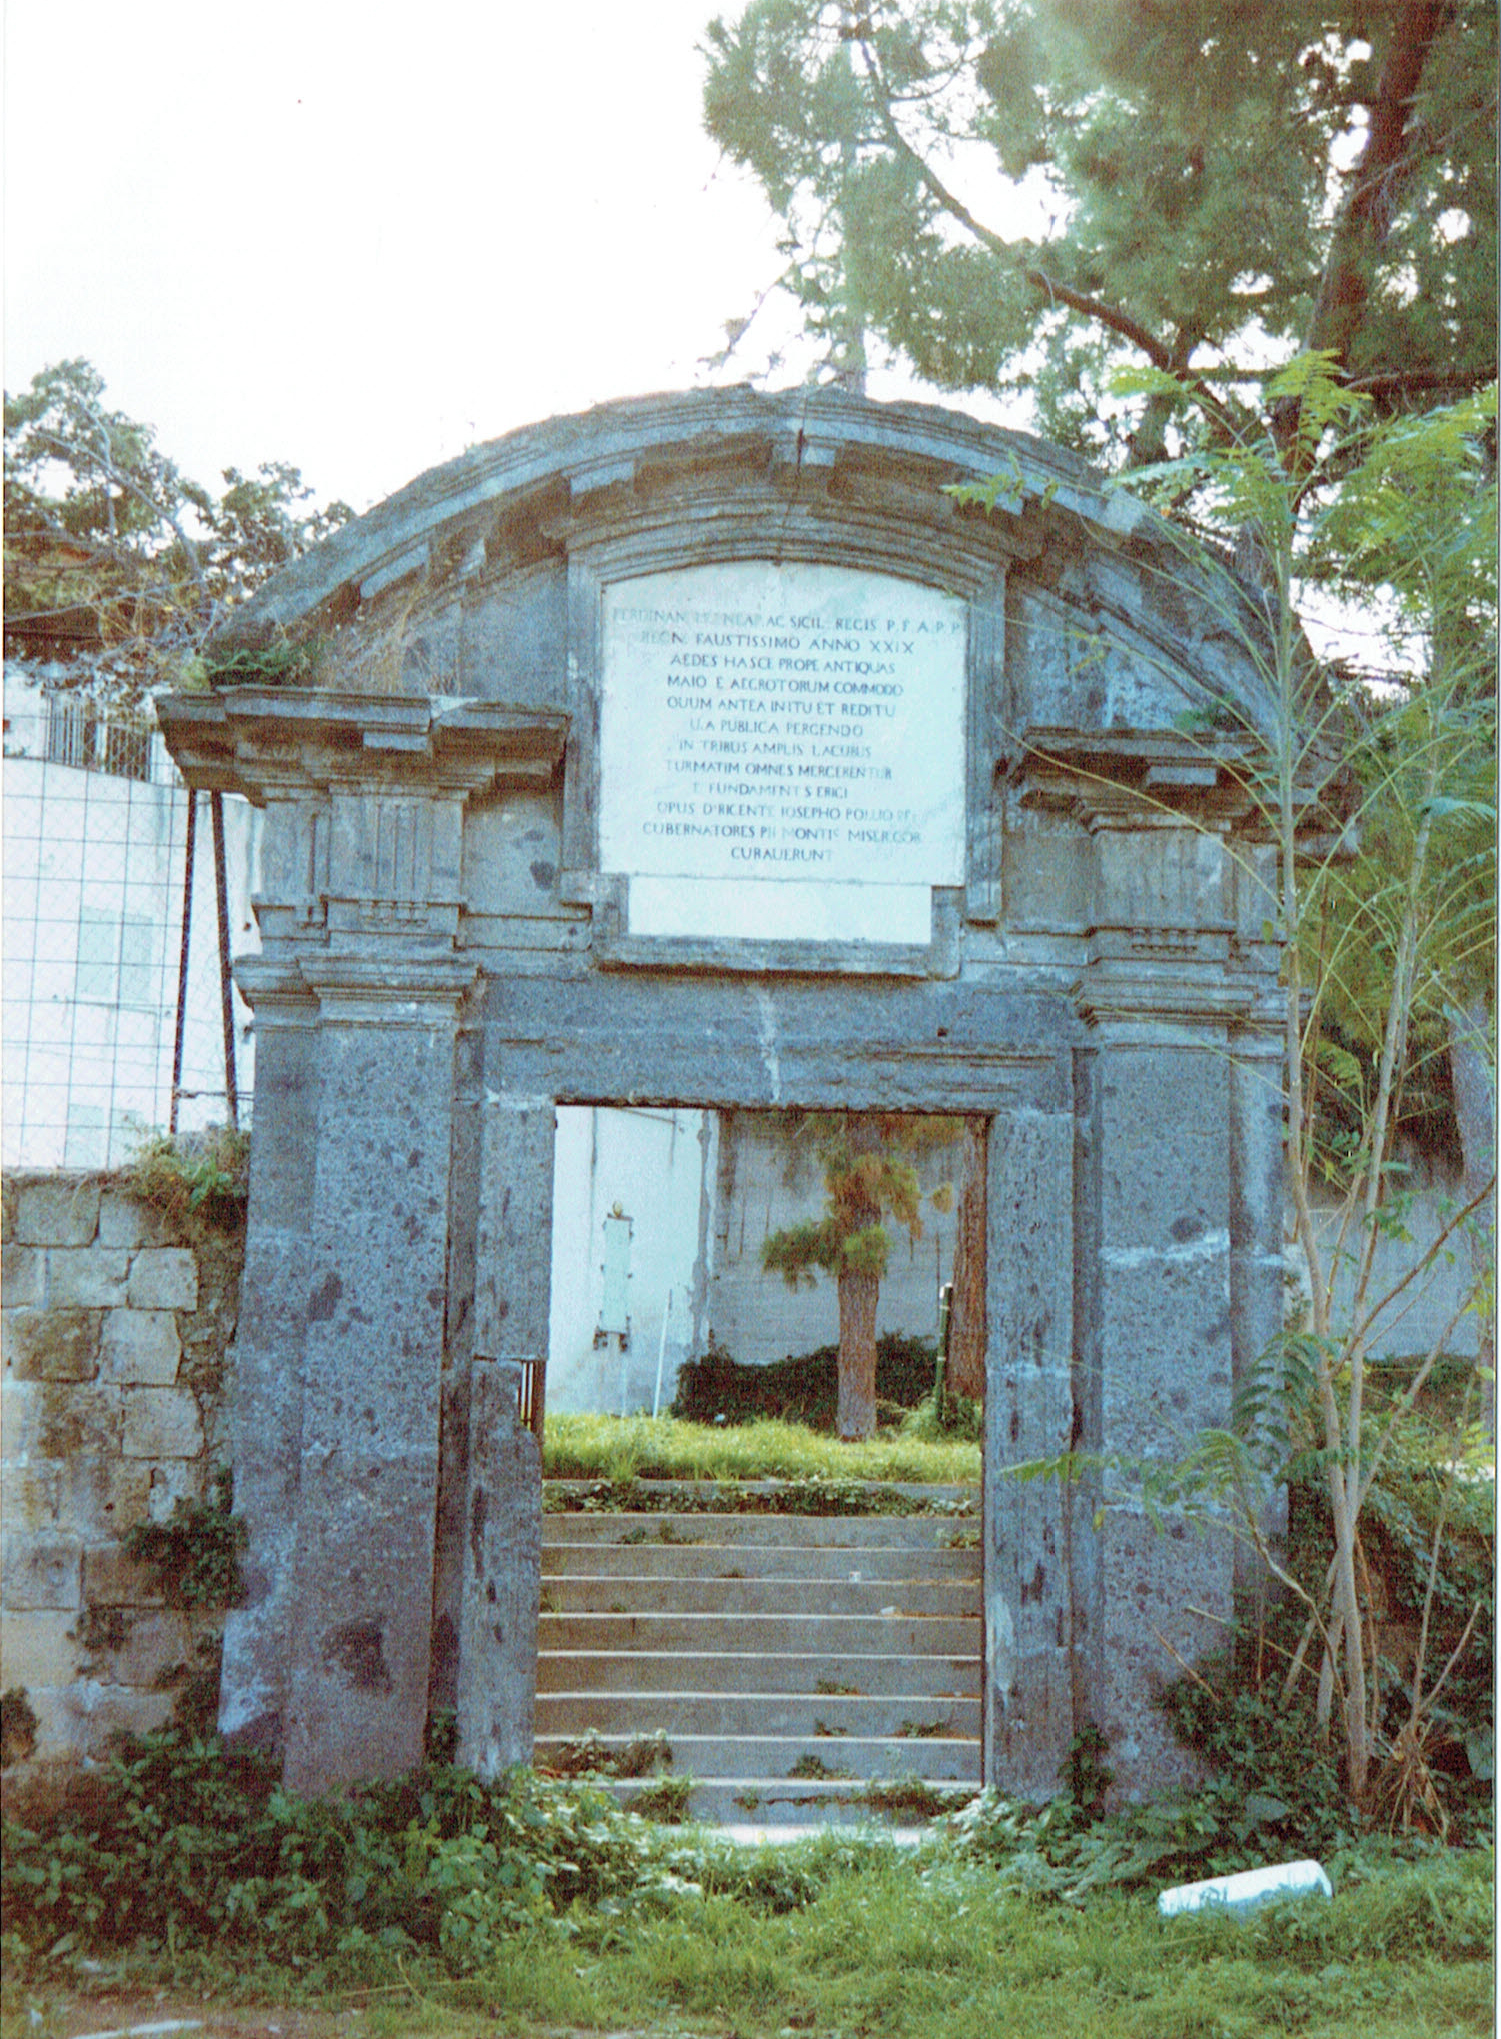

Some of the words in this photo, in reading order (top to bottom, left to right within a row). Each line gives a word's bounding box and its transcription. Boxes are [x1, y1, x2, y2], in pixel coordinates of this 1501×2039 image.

[767, 614, 785, 628] AC
[695, 632, 801, 650] FAUSTISSIMO
[808, 637, 861, 652] ANNO
[869, 640, 915, 655] XXIX
[670, 653, 718, 668] AEDES
[724, 656, 773, 670] HASCE
[779, 657, 820, 672] PROPE
[823, 660, 896, 676] ANTIQUAS
[833, 680, 905, 697] COMMODO
[718, 698, 767, 712] ANTEA
[816, 702, 836, 716] ET
[840, 703, 897, 718] REDITU
[720, 719, 780, 734] PUBLICA
[701, 740, 748, 754] TRIBUS
[752, 742, 804, 756] AMPLIS
[745, 762, 794, 777] OMNES
[657, 800, 696, 815] OPUS
